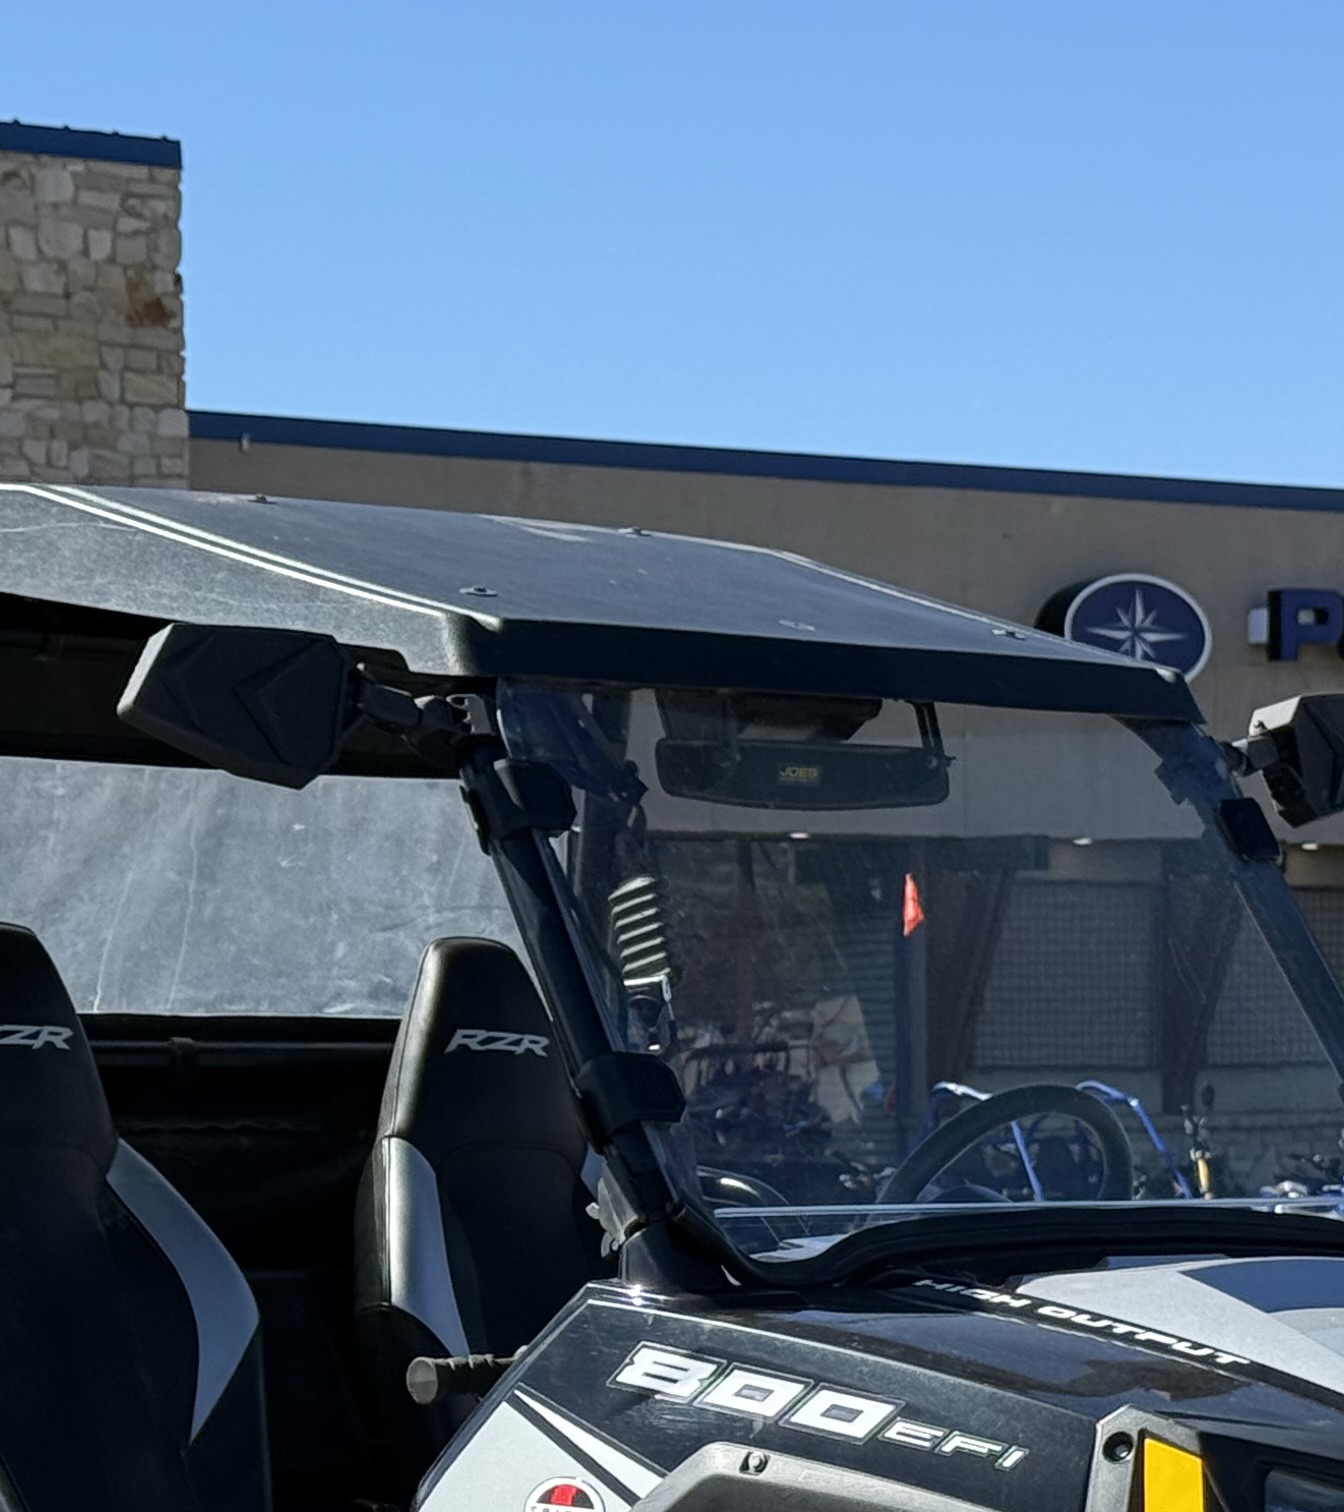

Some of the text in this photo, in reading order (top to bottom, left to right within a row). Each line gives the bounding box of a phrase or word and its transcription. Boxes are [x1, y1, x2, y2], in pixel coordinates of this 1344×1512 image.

[444, 1029, 550, 1057] RZR
[912, 1278, 1252, 1366] HIGH OUTPUT
